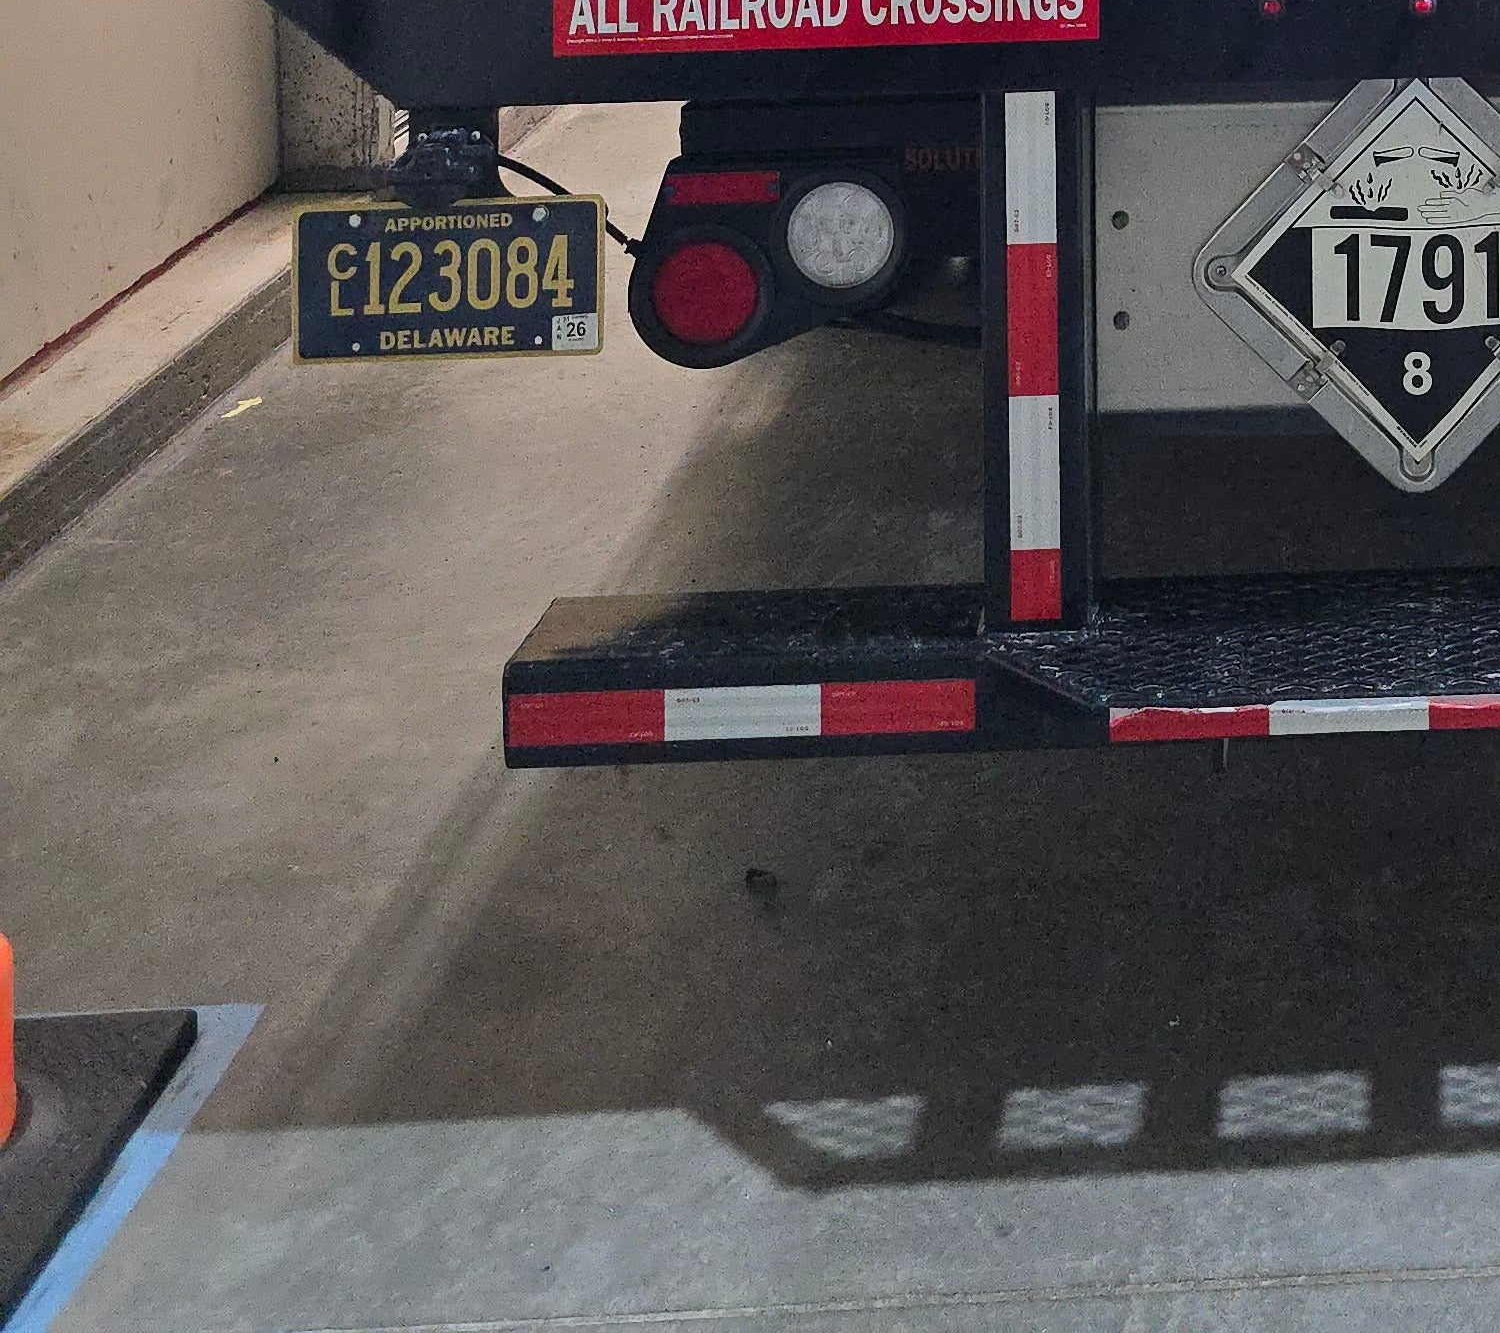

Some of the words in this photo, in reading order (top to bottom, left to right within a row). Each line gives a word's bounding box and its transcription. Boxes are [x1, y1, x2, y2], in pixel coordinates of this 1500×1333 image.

[384, 212, 513, 234] APPORTIONED
[362, 234, 575, 316] 123084
[379, 325, 516, 351] DELAWARE
[566, 320, 587, 338] 26
[1402, 351, 1433, 396] 8
